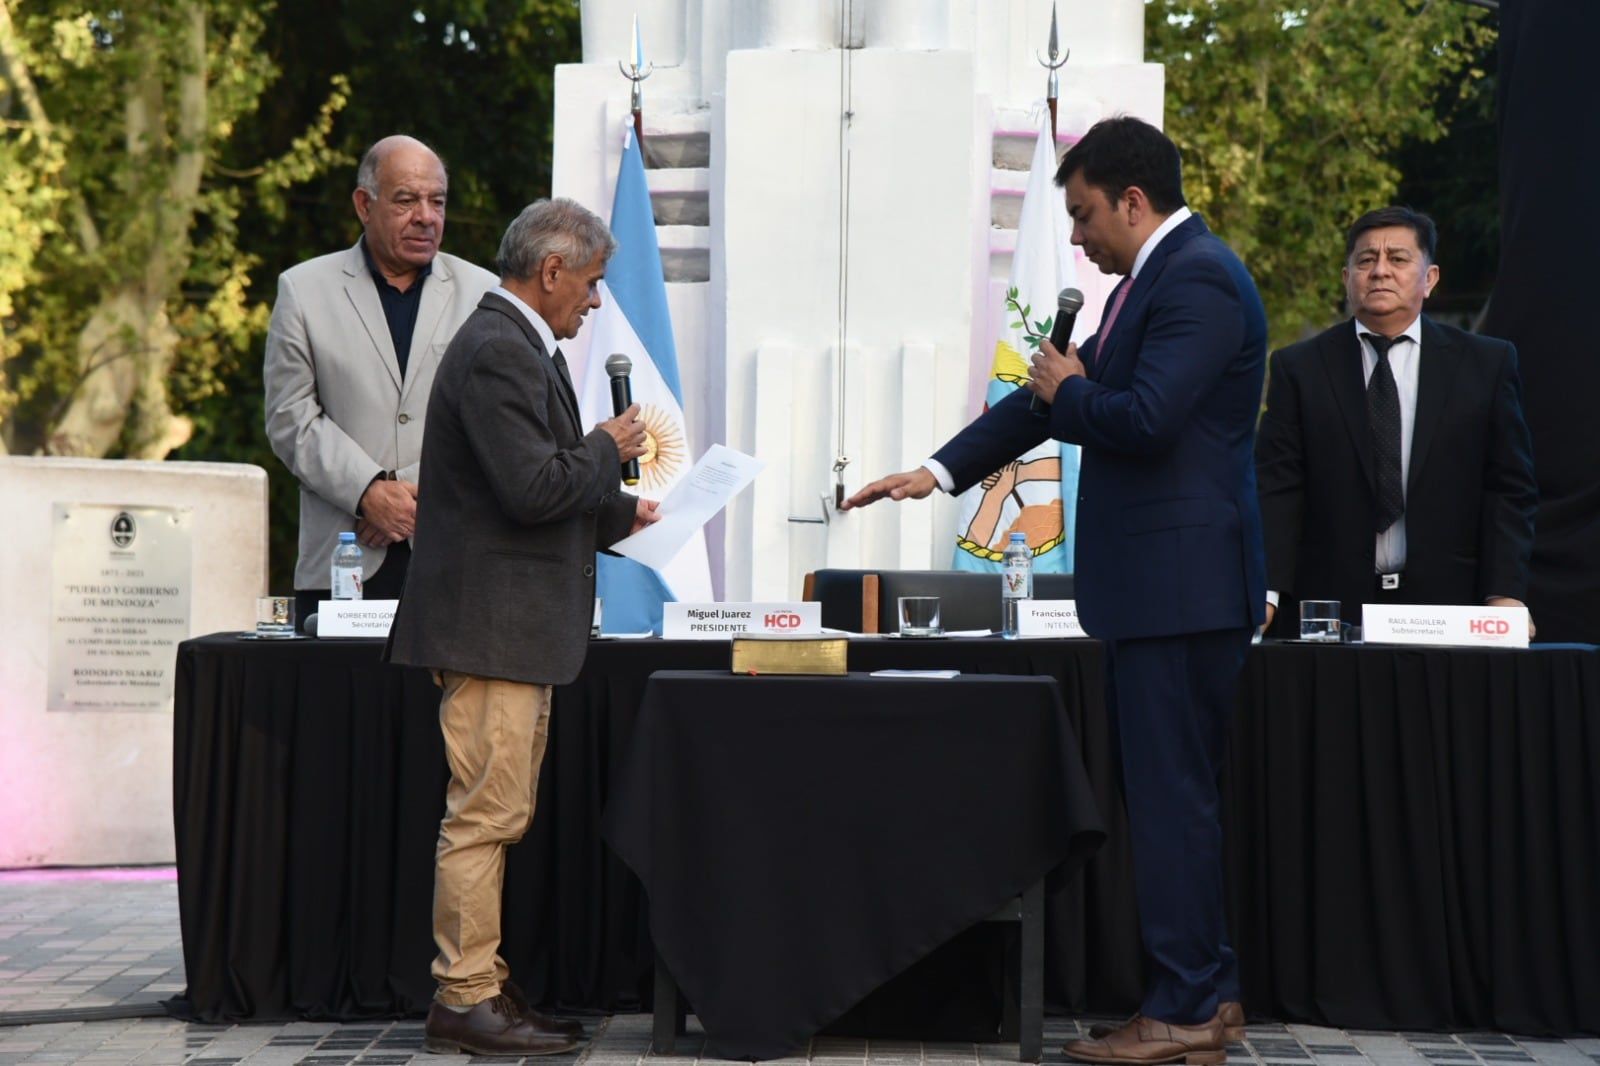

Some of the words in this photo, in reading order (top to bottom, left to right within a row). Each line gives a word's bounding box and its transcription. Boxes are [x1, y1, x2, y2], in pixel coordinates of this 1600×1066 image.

[65, 585, 112, 594] "PUEBLO
[114, 585, 121, 595] Y
[122, 586, 179, 596] GOBIERNO
[83, 598, 97, 607] DE
[101, 599, 160, 608] MENDOZA"
[687, 609, 719, 620] Miguel
[721, 610, 752, 619] Juarez
[121, 617, 185, 625] DEPARTAMENTO
[764, 614, 801, 628] HCD
[1409, 618, 1447, 626] AGUILERA
[690, 623, 748, 632] PRESIDENTE
[1391, 627, 1445, 636] Subsecretario
[1469, 619, 1510, 635] HCD
[73, 668, 122, 678] RODOLFO
